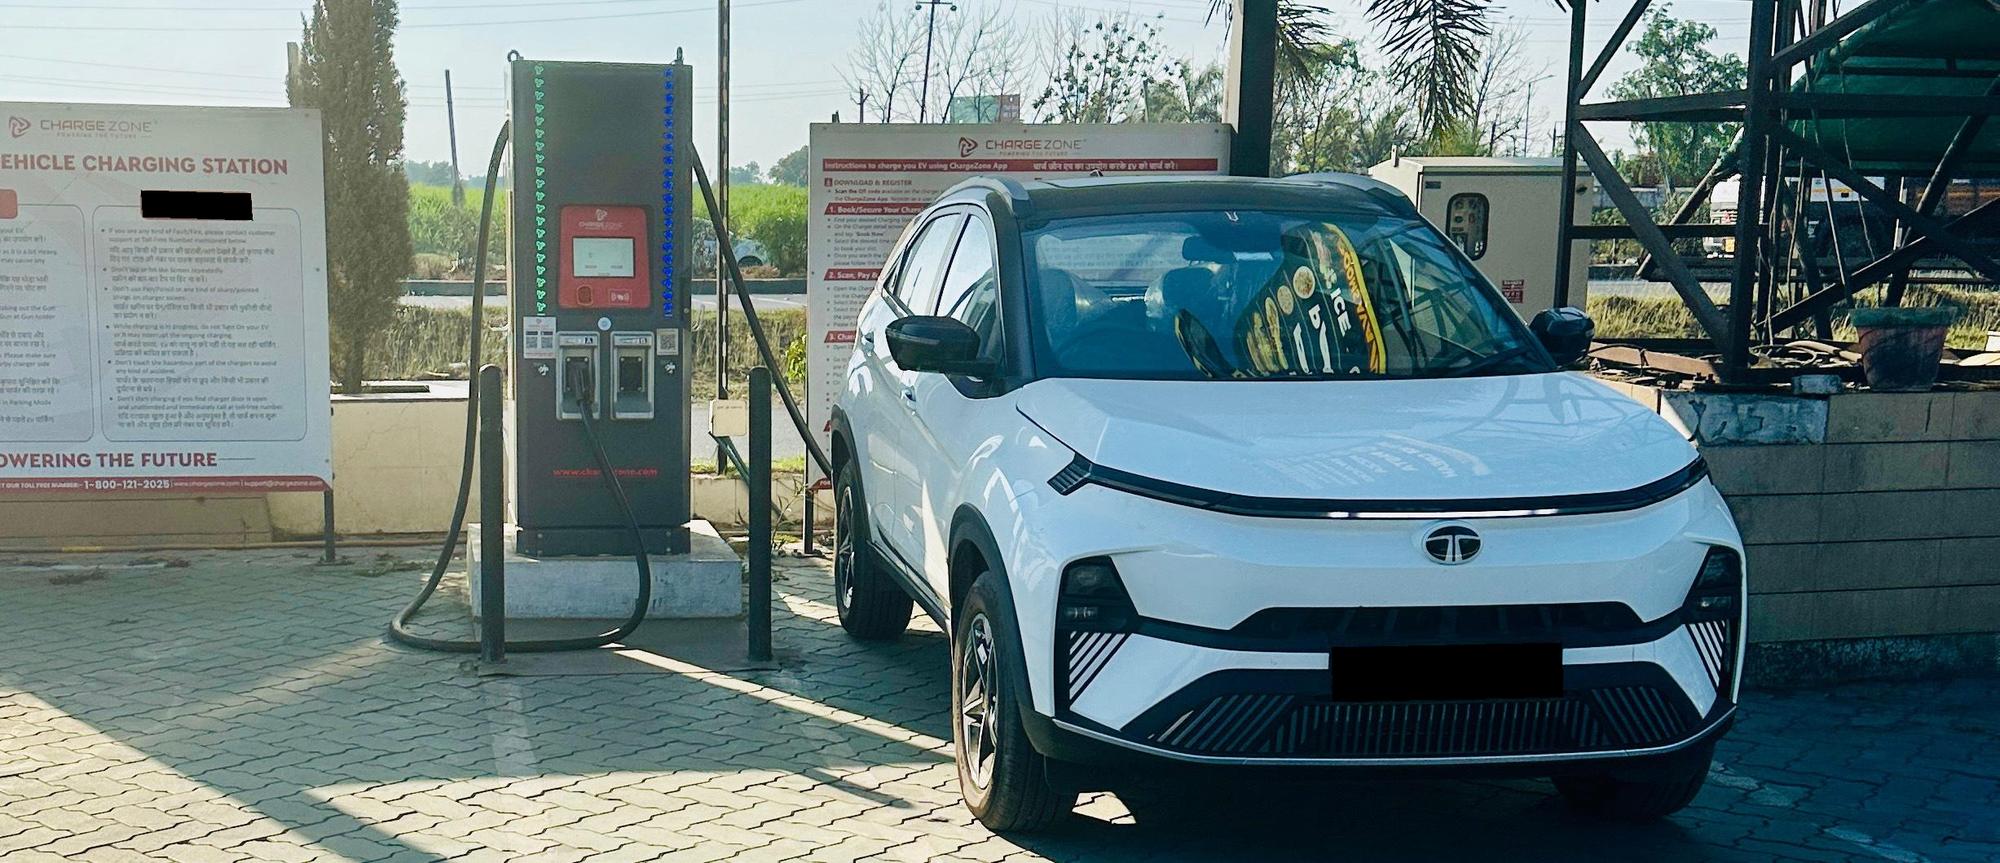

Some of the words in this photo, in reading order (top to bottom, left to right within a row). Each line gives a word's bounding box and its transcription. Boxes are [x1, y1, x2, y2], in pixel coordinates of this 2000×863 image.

[82, 155, 196, 173] CHARGING
[202, 157, 288, 175] STATION
[825, 162, 866, 170] Instructions
[868, 162, 876, 170] to
[878, 162, 902, 170] charge
[903, 162, 916, 170] you
[918, 162, 927, 170] EV
[928, 162, 948, 170] using
[949, 162, 992, 170] ChargeZone
[993, 162, 1008, 170] App
[0, 452, 91, 468] OWERING
[96, 453, 134, 468] THE
[141, 452, 217, 468] FUTURE
[84, 480, 170, 490] 1-800-121-2025
